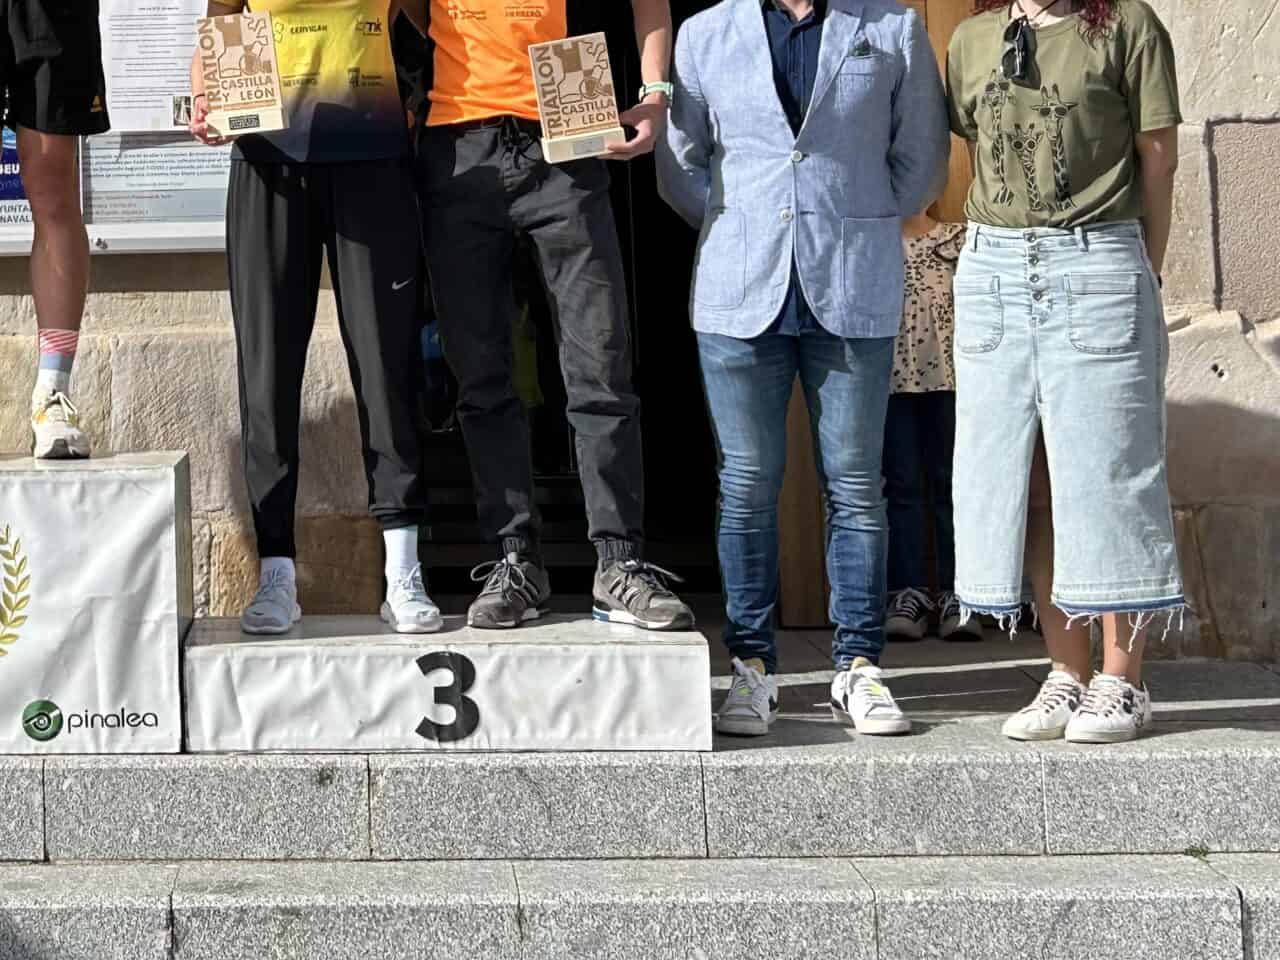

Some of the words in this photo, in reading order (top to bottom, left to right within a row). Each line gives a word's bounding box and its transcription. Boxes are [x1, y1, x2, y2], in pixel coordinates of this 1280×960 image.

[197, 18, 222, 113] TRIATLON
[221, 76, 273, 90] CASTILLA
[222, 93, 230, 102] Y
[535, 46, 564, 140] TRIATLON
[561, 99, 615, 116] CASTILLA
[564, 119, 571, 128] Y
[0, 215, 33, 224] NAVAL
[415, 651, 480, 742] 3
[68, 707, 159, 734] pinalea
